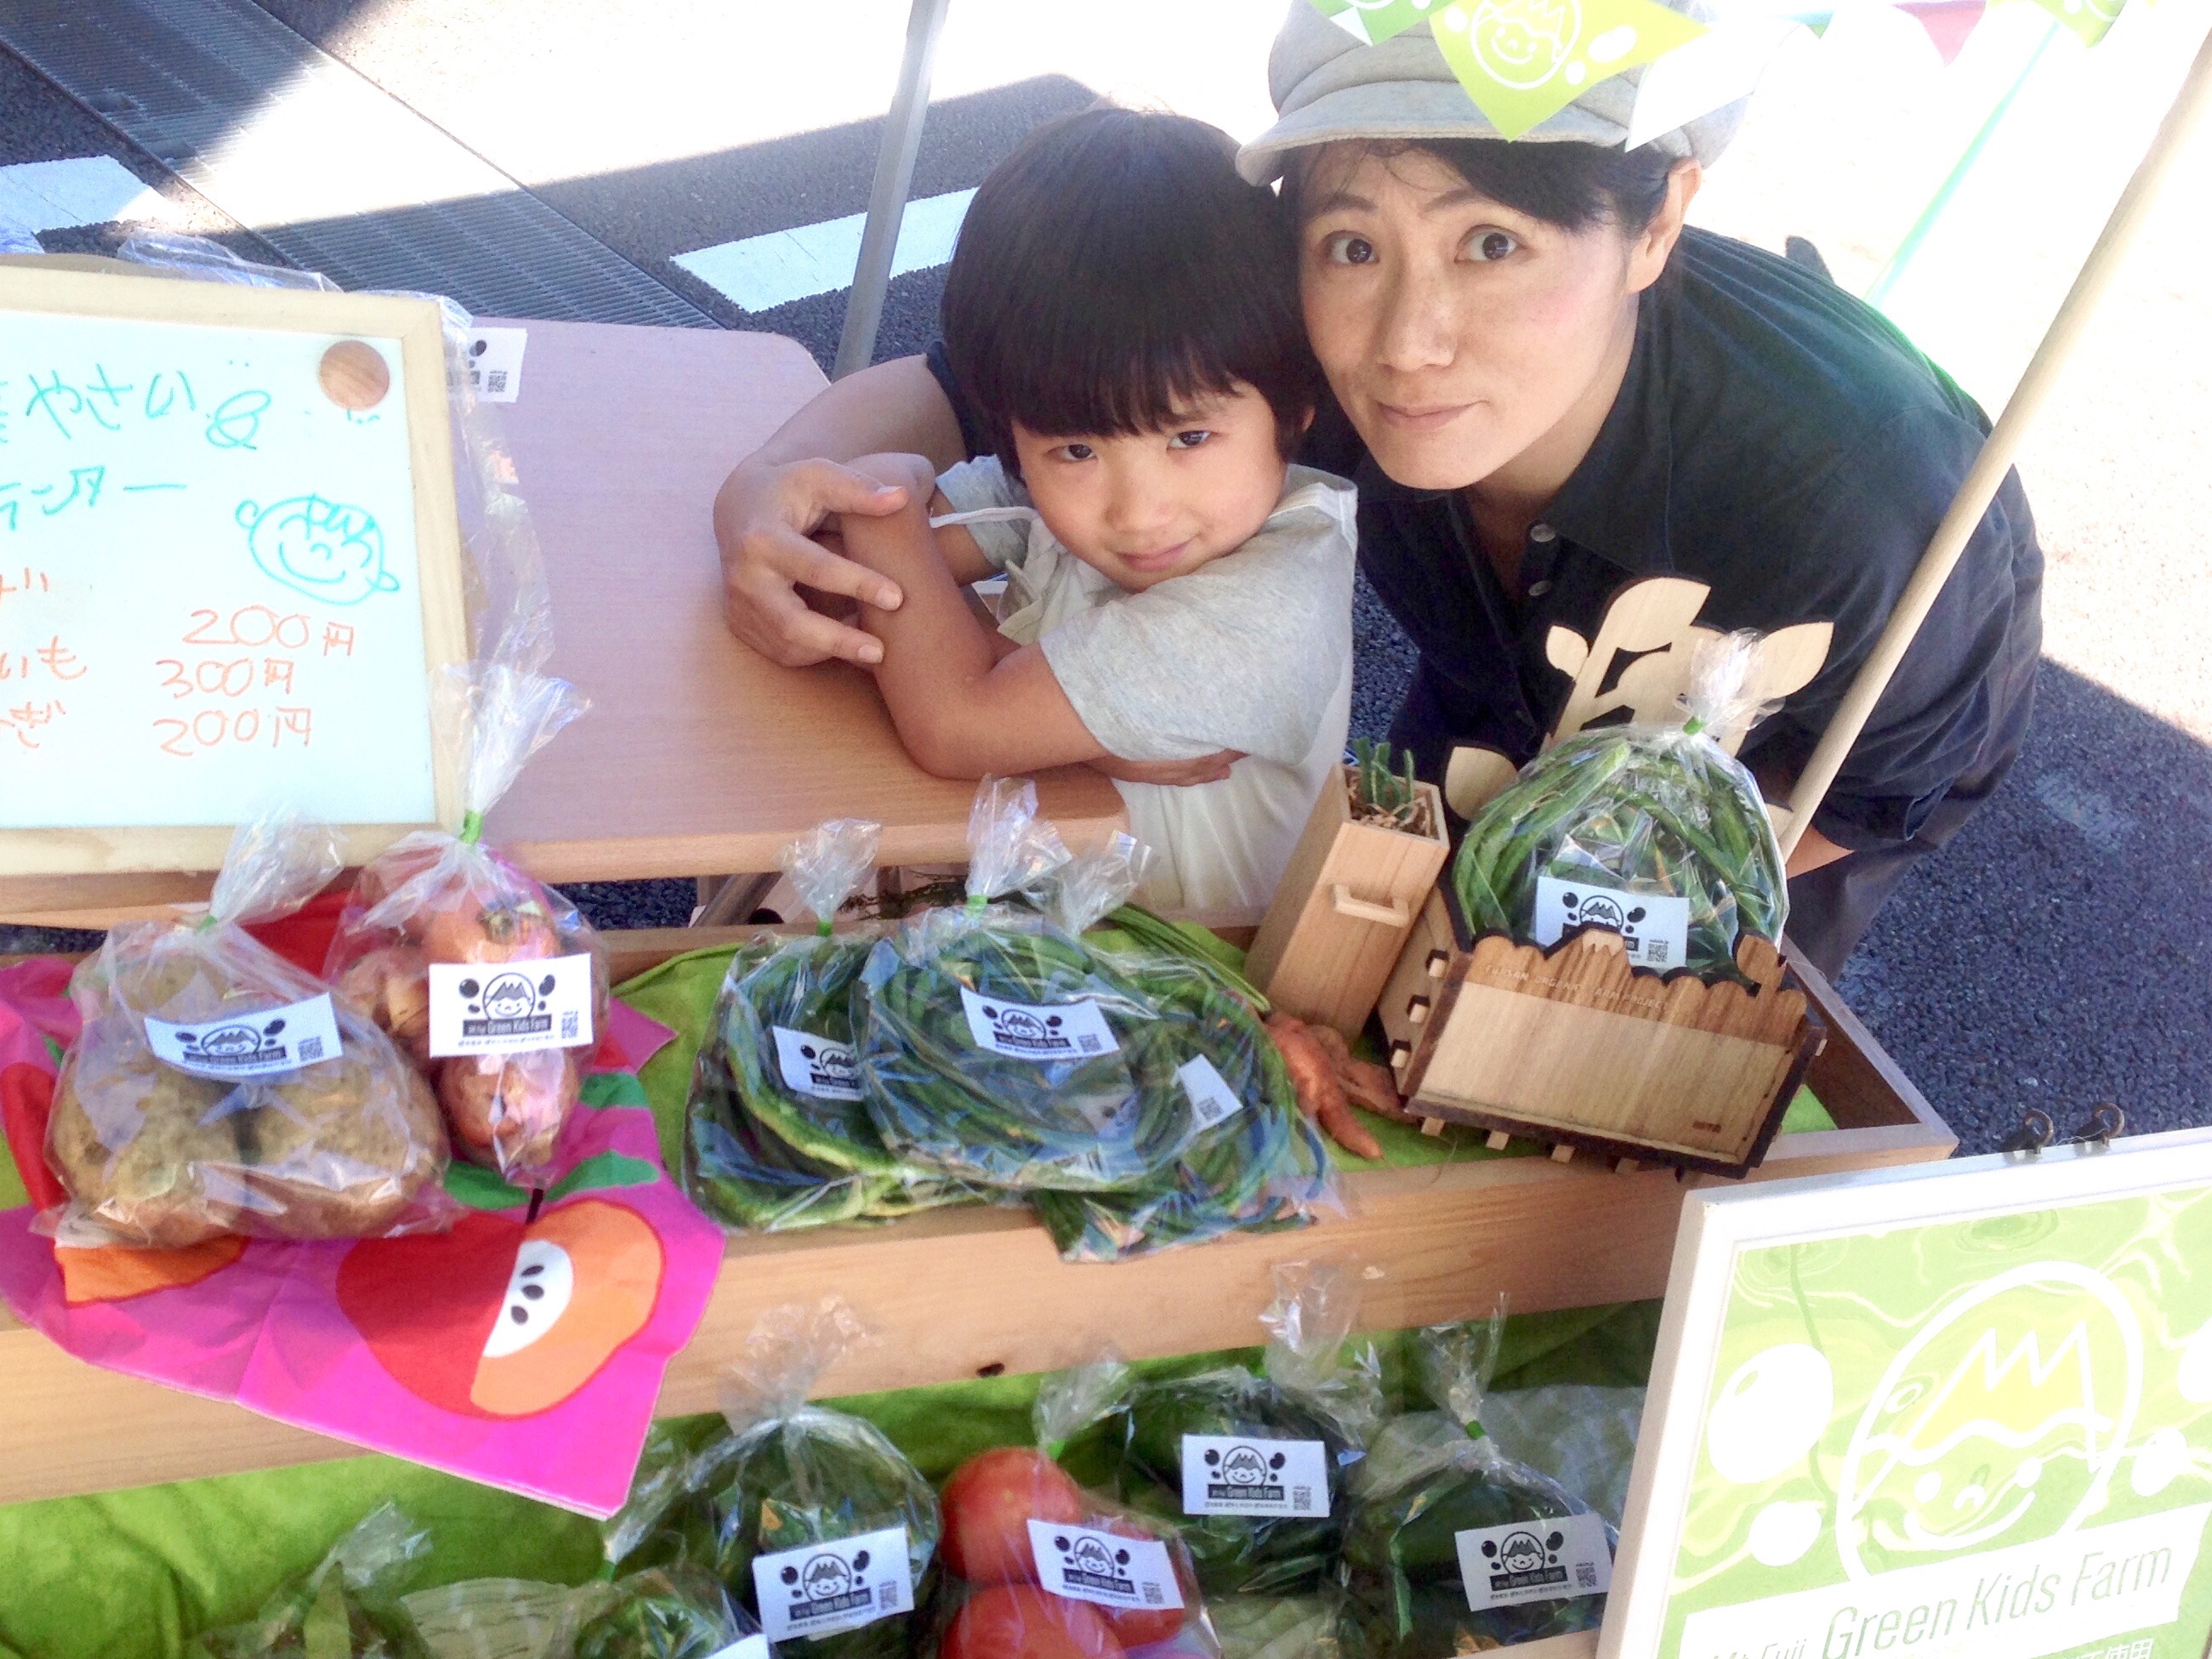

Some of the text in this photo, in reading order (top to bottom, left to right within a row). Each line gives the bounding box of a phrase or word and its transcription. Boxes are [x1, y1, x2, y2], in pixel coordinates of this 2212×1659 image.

[0, 363, 196, 440] やさい
[1822, 1605, 1959, 1659] Green
[1965, 1564, 2061, 1631] Kids
[2071, 1546, 2173, 1606] Farm
